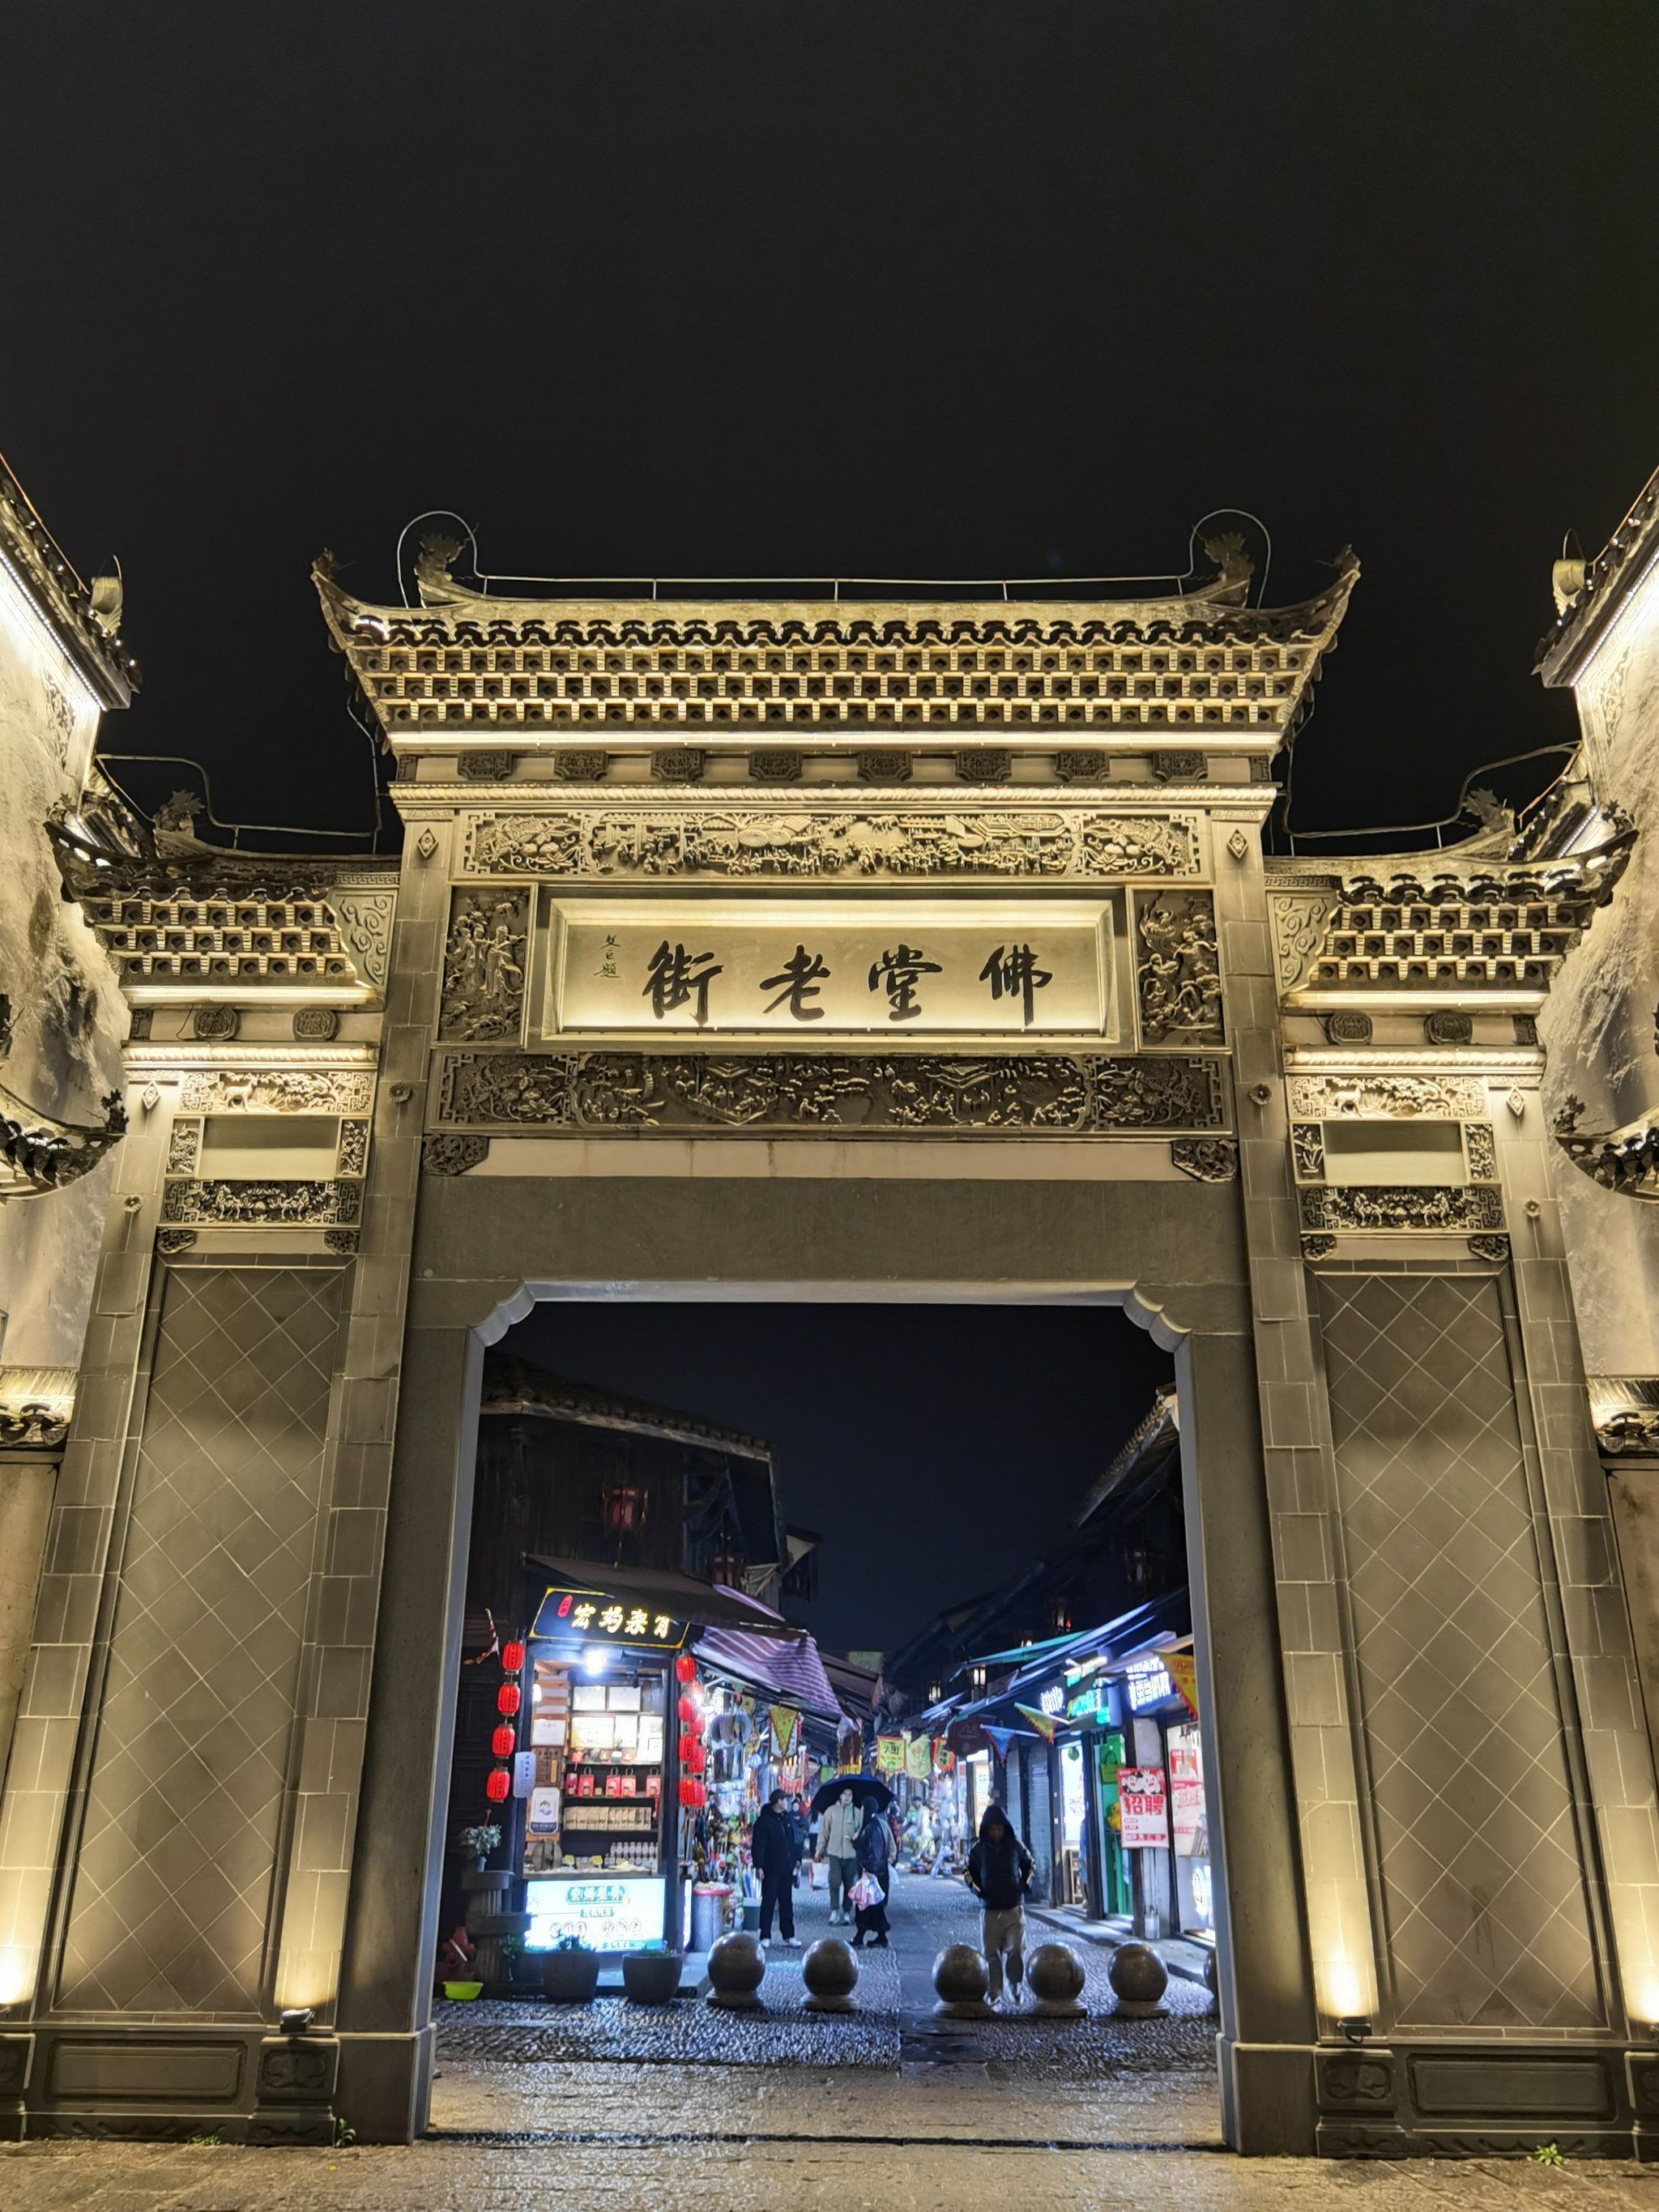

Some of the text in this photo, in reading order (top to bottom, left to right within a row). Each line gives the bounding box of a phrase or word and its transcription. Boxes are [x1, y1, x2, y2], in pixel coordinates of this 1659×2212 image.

[642, 940, 1052, 1025] 佛堂老街
[1123, 1795, 1165, 1815] 招聘
